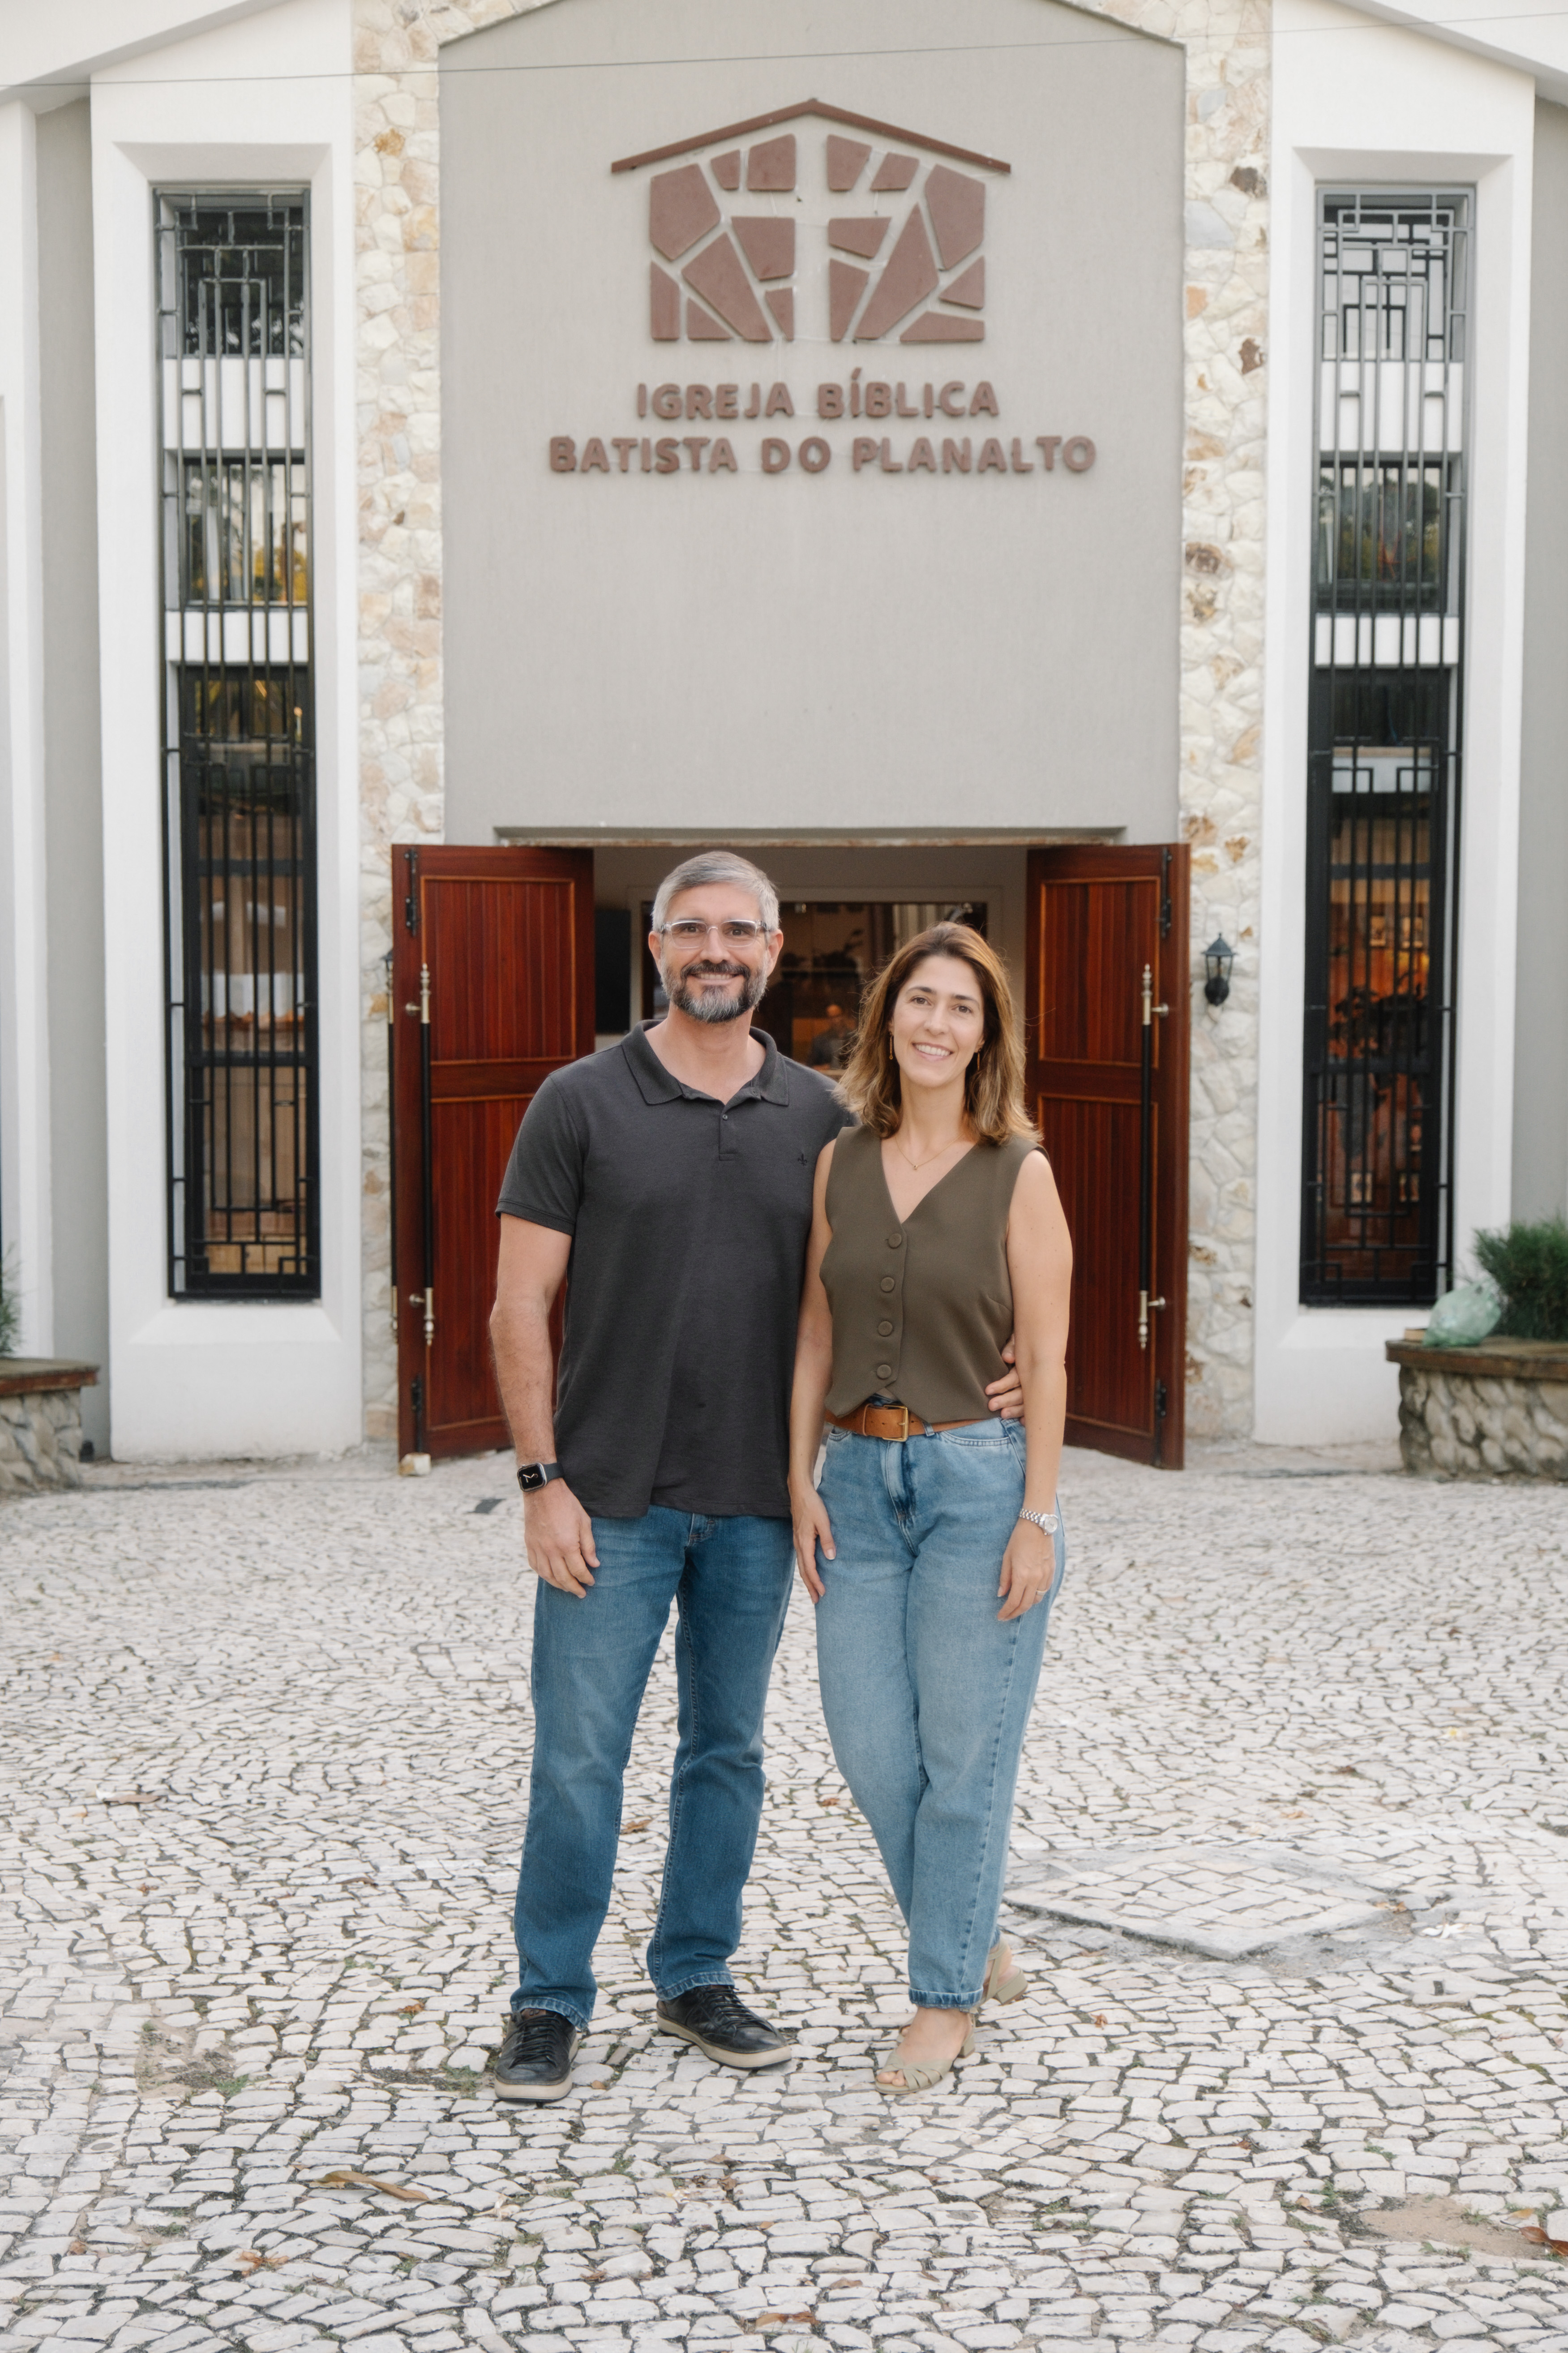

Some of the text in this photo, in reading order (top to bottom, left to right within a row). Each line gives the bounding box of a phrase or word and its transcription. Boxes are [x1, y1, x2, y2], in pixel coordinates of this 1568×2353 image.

[637, 366, 1000, 419] IGREJA BÍBLICA
[549, 435, 1097, 473] BATISTA DO PLANALTO
